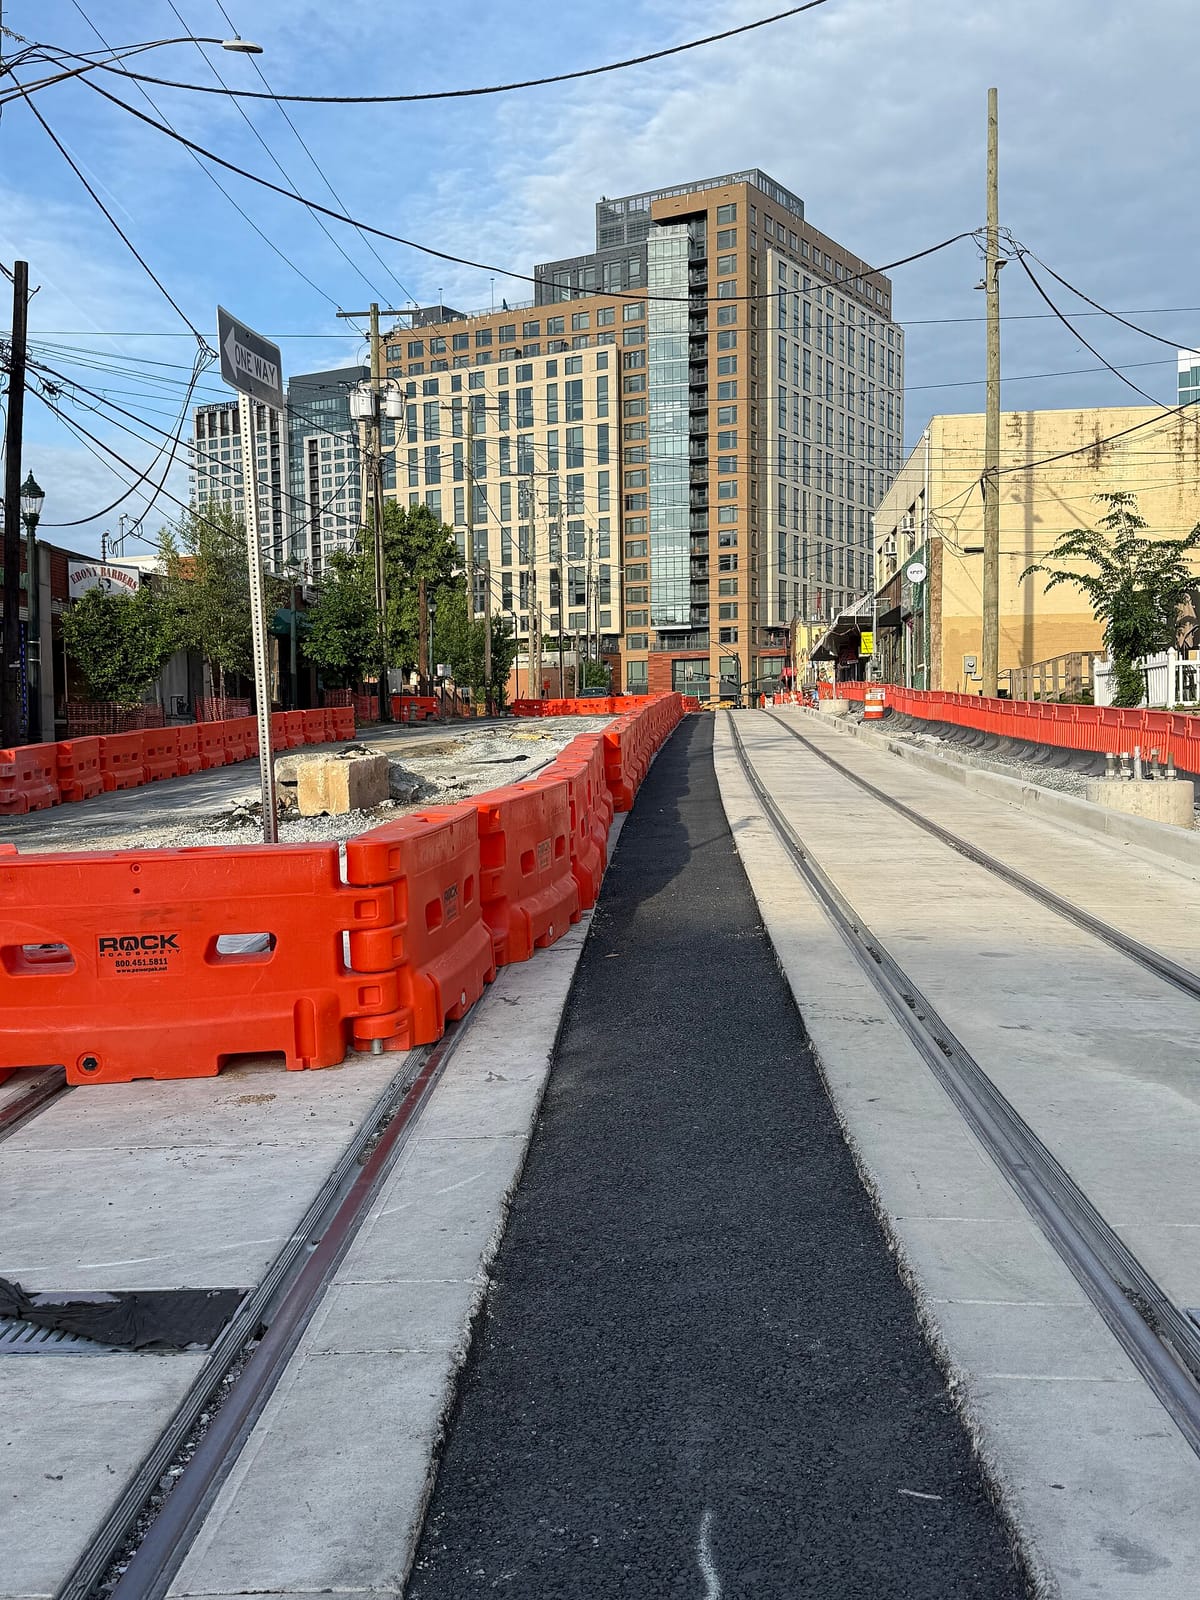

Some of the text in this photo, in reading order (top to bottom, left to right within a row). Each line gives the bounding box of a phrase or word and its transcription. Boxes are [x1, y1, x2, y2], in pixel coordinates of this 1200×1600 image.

[234, 344, 275, 385] ONE WAY
[70, 567, 138, 590] EBONY BARBERS
[99, 934, 179, 952] ROCK
[115, 958, 168, 967] 800.451.5811
